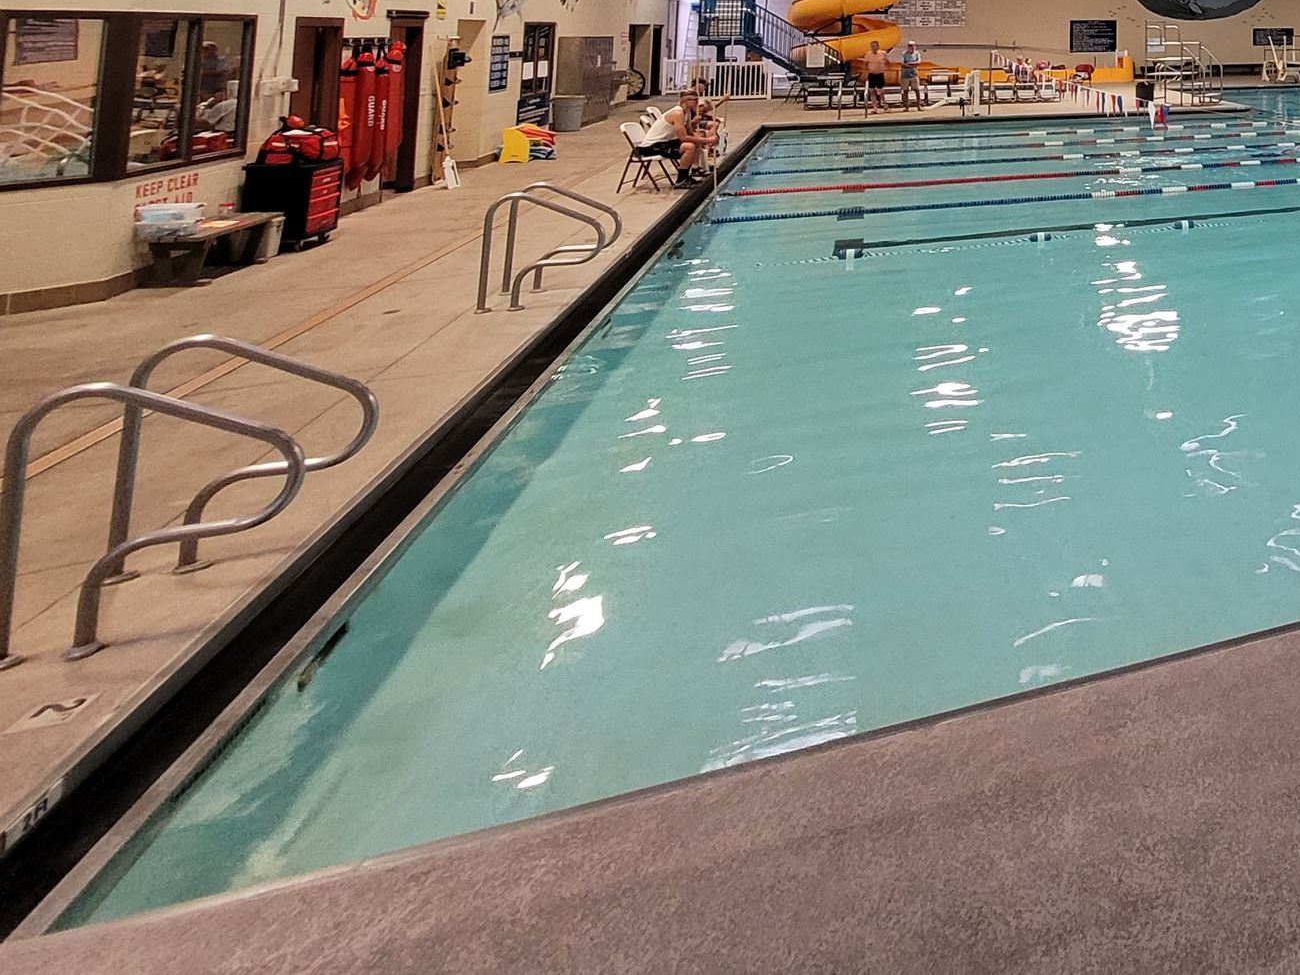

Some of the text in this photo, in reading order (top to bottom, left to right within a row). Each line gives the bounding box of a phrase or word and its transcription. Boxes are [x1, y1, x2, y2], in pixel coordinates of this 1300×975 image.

[368, 95, 376, 127] GUARD
[135, 172, 199, 199] KEEP CLEAR
